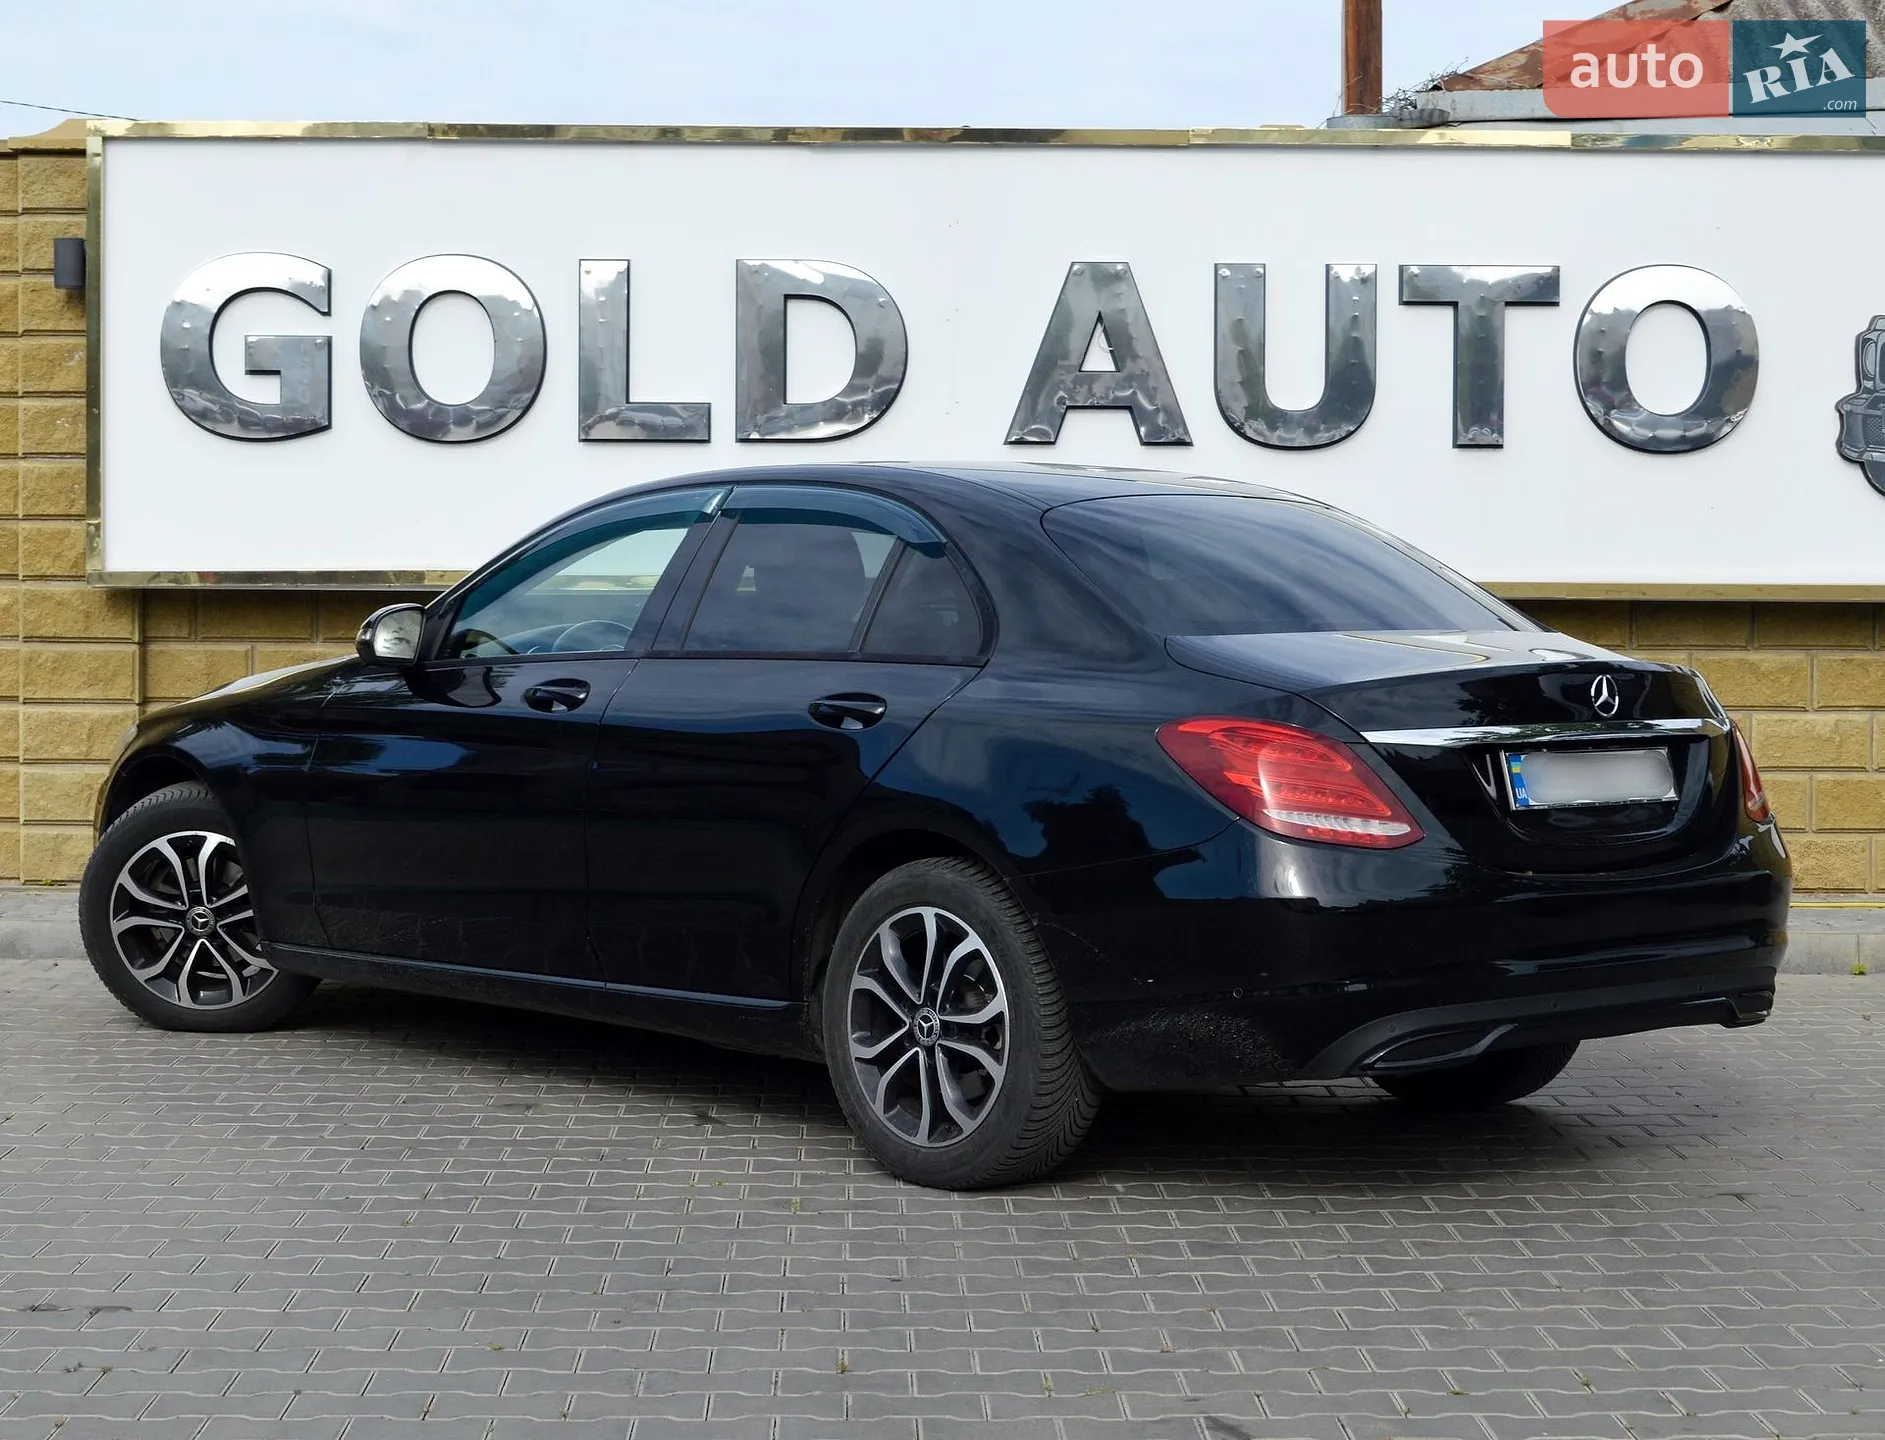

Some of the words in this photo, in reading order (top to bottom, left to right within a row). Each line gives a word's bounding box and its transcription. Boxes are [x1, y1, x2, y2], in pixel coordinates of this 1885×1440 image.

[160, 251, 908, 444] GOLD
[1004, 261, 1760, 453] AUTO
[1515, 787, 1528, 799] UA
